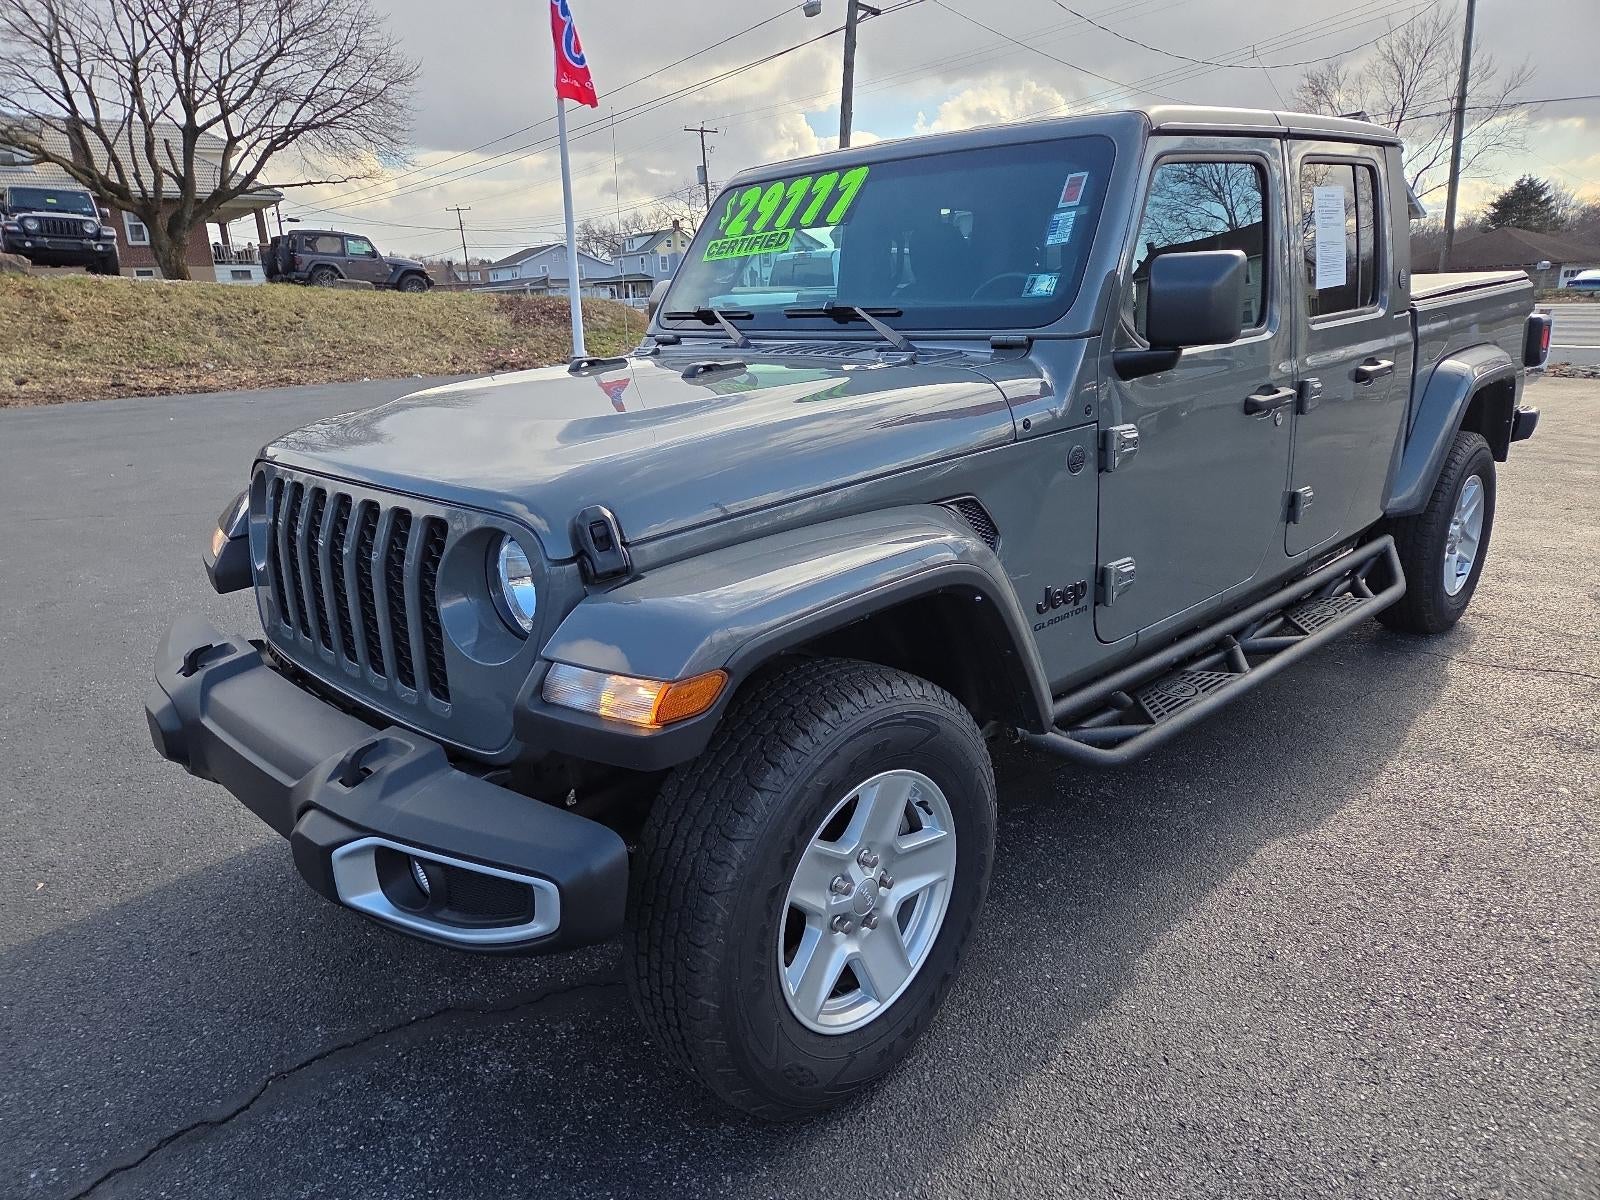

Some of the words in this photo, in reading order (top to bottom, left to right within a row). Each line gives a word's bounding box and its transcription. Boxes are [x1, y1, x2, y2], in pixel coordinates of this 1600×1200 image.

[705, 230, 790, 258] CERTIFIED
[1036, 578, 1088, 615] Jeep
[1034, 604, 1088, 632] GLADIATOR
